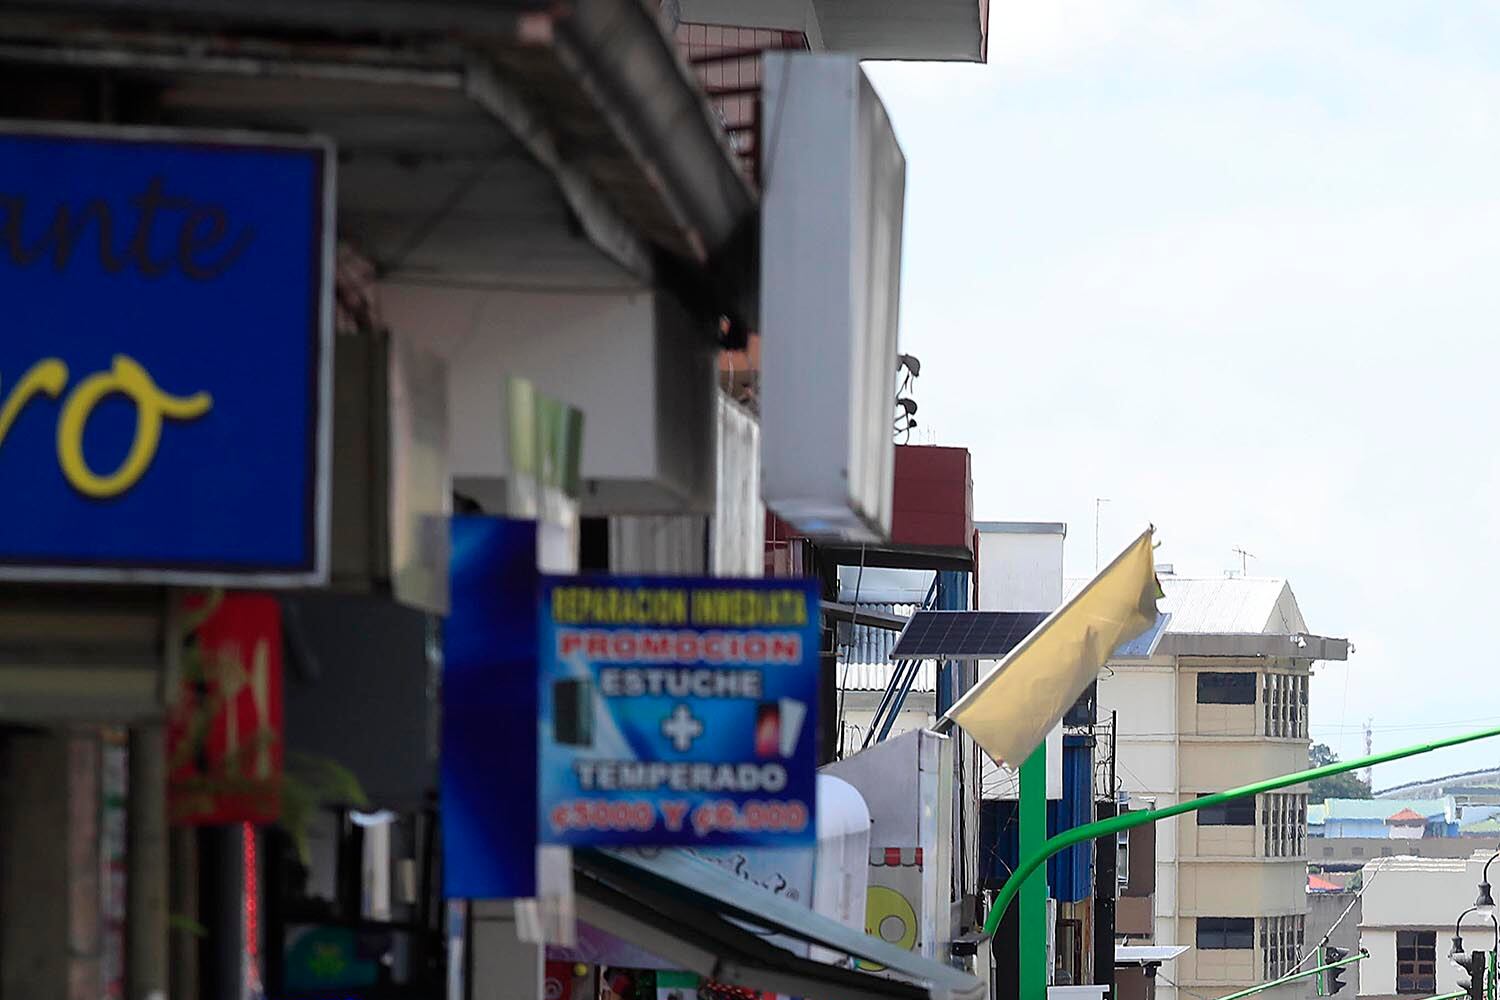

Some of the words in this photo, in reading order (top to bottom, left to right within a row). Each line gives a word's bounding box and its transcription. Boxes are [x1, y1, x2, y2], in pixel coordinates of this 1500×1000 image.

[558, 630, 801, 665] PROMOCION
[601, 667, 762, 697] ESTUCHE
[575, 760, 787, 791] TEMPERADO
